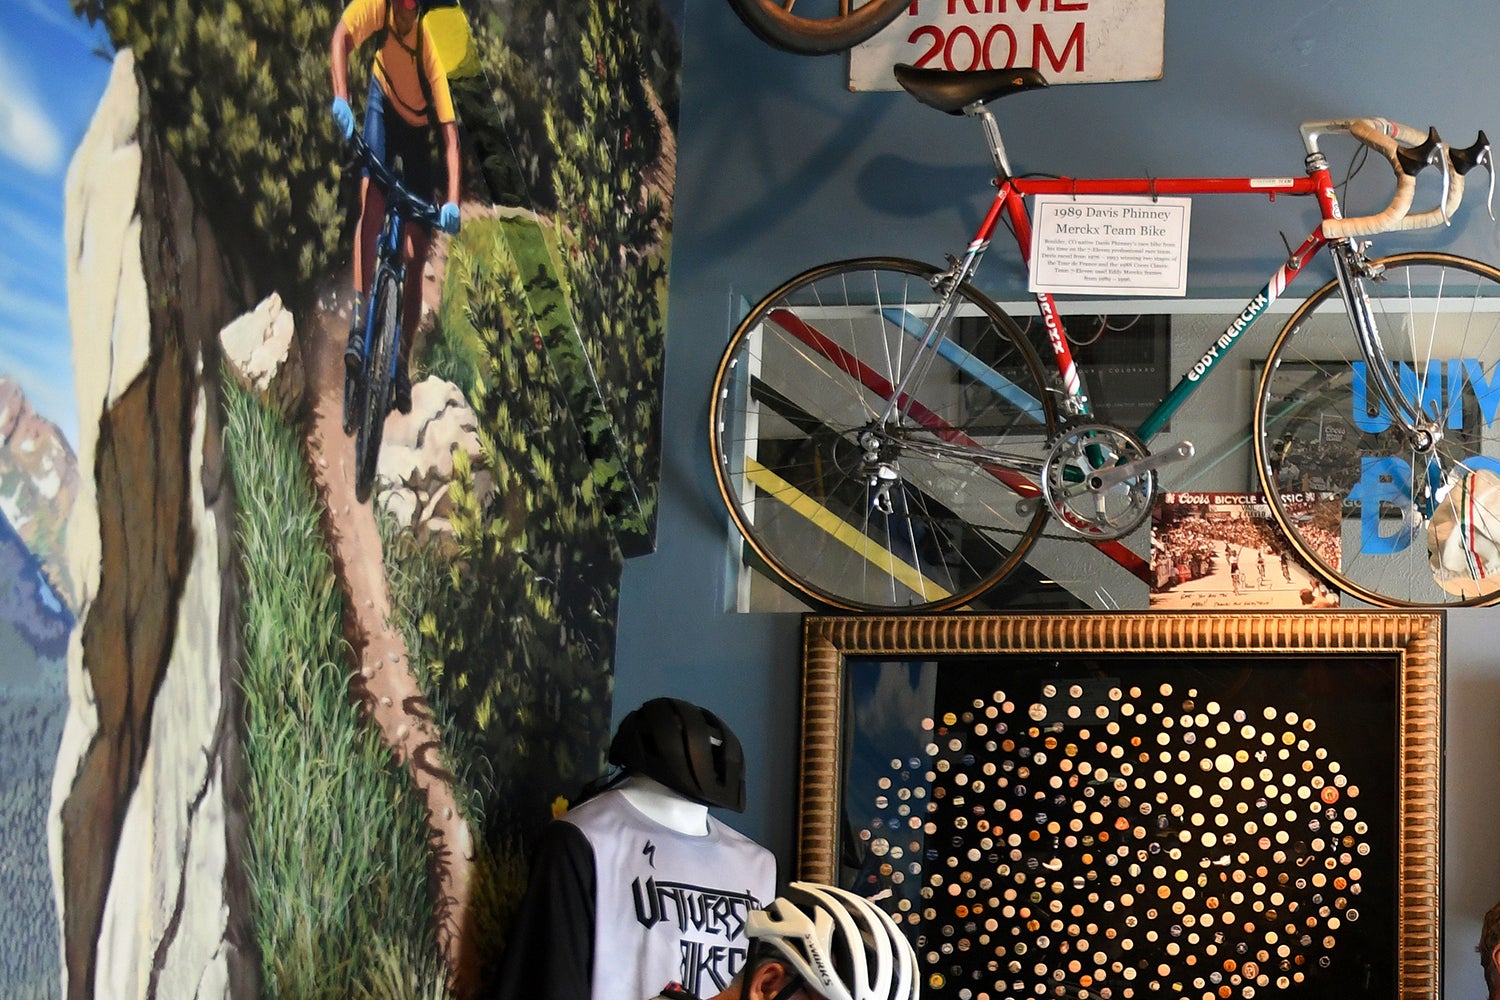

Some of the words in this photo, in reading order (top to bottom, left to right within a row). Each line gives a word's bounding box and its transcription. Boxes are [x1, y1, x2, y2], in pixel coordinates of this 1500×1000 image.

[907, 24, 1018, 72] 200
[1032, 22, 1085, 73] M
[1054, 207, 1082, 219] 1989
[1086, 207, 1119, 218] Davis
[1122, 208, 1171, 221] Phinney
[1056, 223, 1100, 235] Merckx
[1103, 225, 1136, 236] Team
[1140, 226, 1166, 237] Bike
[1187, 344, 1219, 383] EDDY
[1217, 293, 1269, 350] MERCKX
[1178, 493, 1211, 505] Coors
[1214, 495, 1257, 505] BICYCLE
[804, 933, 833, 987] S-WORKS
